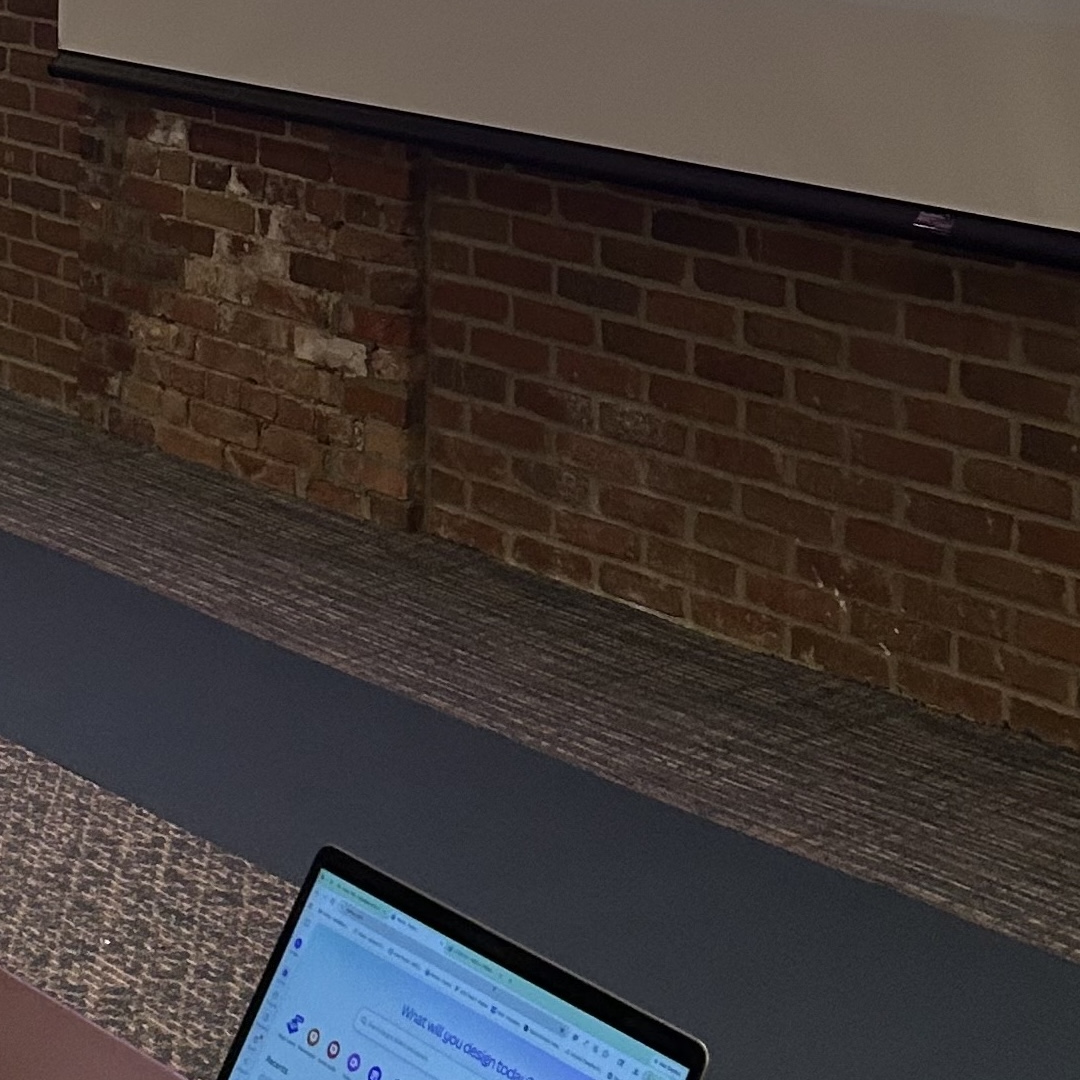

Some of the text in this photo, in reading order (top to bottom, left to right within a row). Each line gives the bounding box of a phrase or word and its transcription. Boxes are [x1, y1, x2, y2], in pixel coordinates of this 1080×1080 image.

[401, 1004, 427, 1029] What
[427, 1022, 445, 1038] will
[442, 1030, 463, 1050] you
[463, 1042, 496, 1069] design
[497, 1059, 535, 1080] toda
